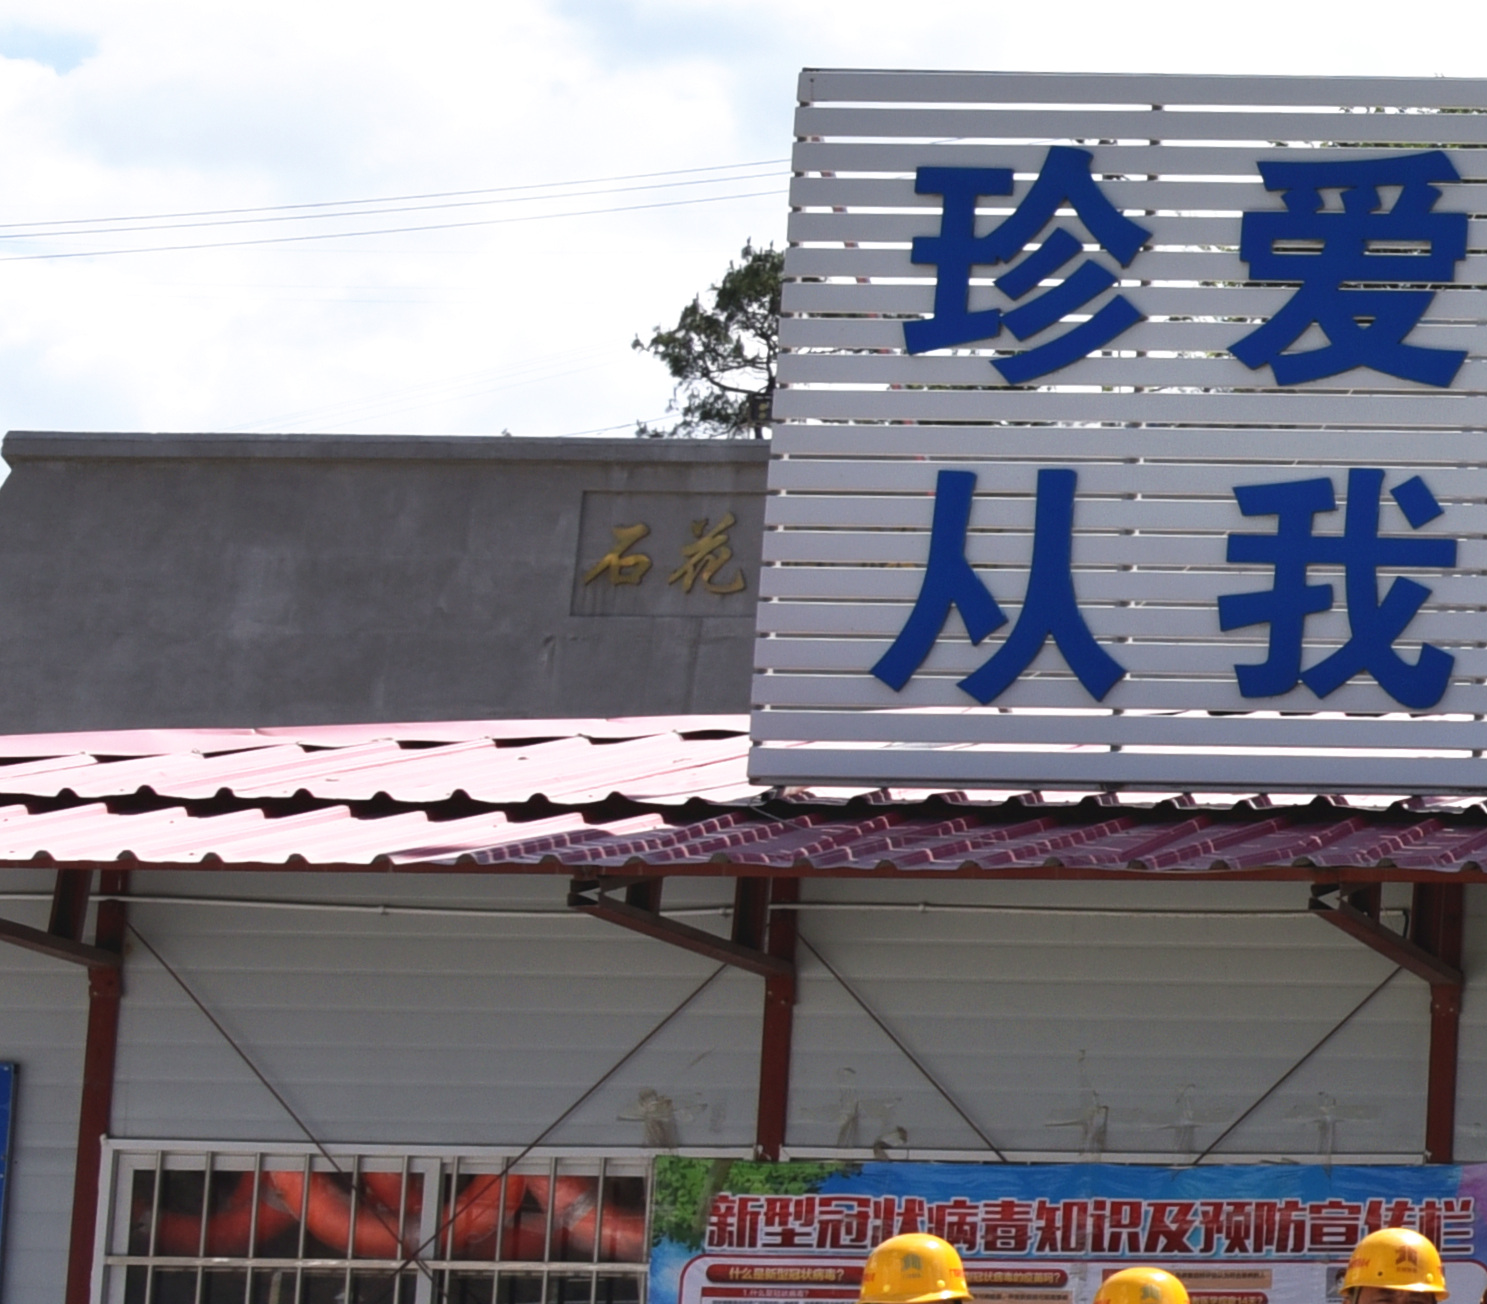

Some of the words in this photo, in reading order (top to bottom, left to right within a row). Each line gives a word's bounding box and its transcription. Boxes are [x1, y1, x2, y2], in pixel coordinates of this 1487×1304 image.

[583, 510, 747, 594] 石花
[708, 1194, 1474, 1254] 新型冠状病毒知识及预防宣传栏
